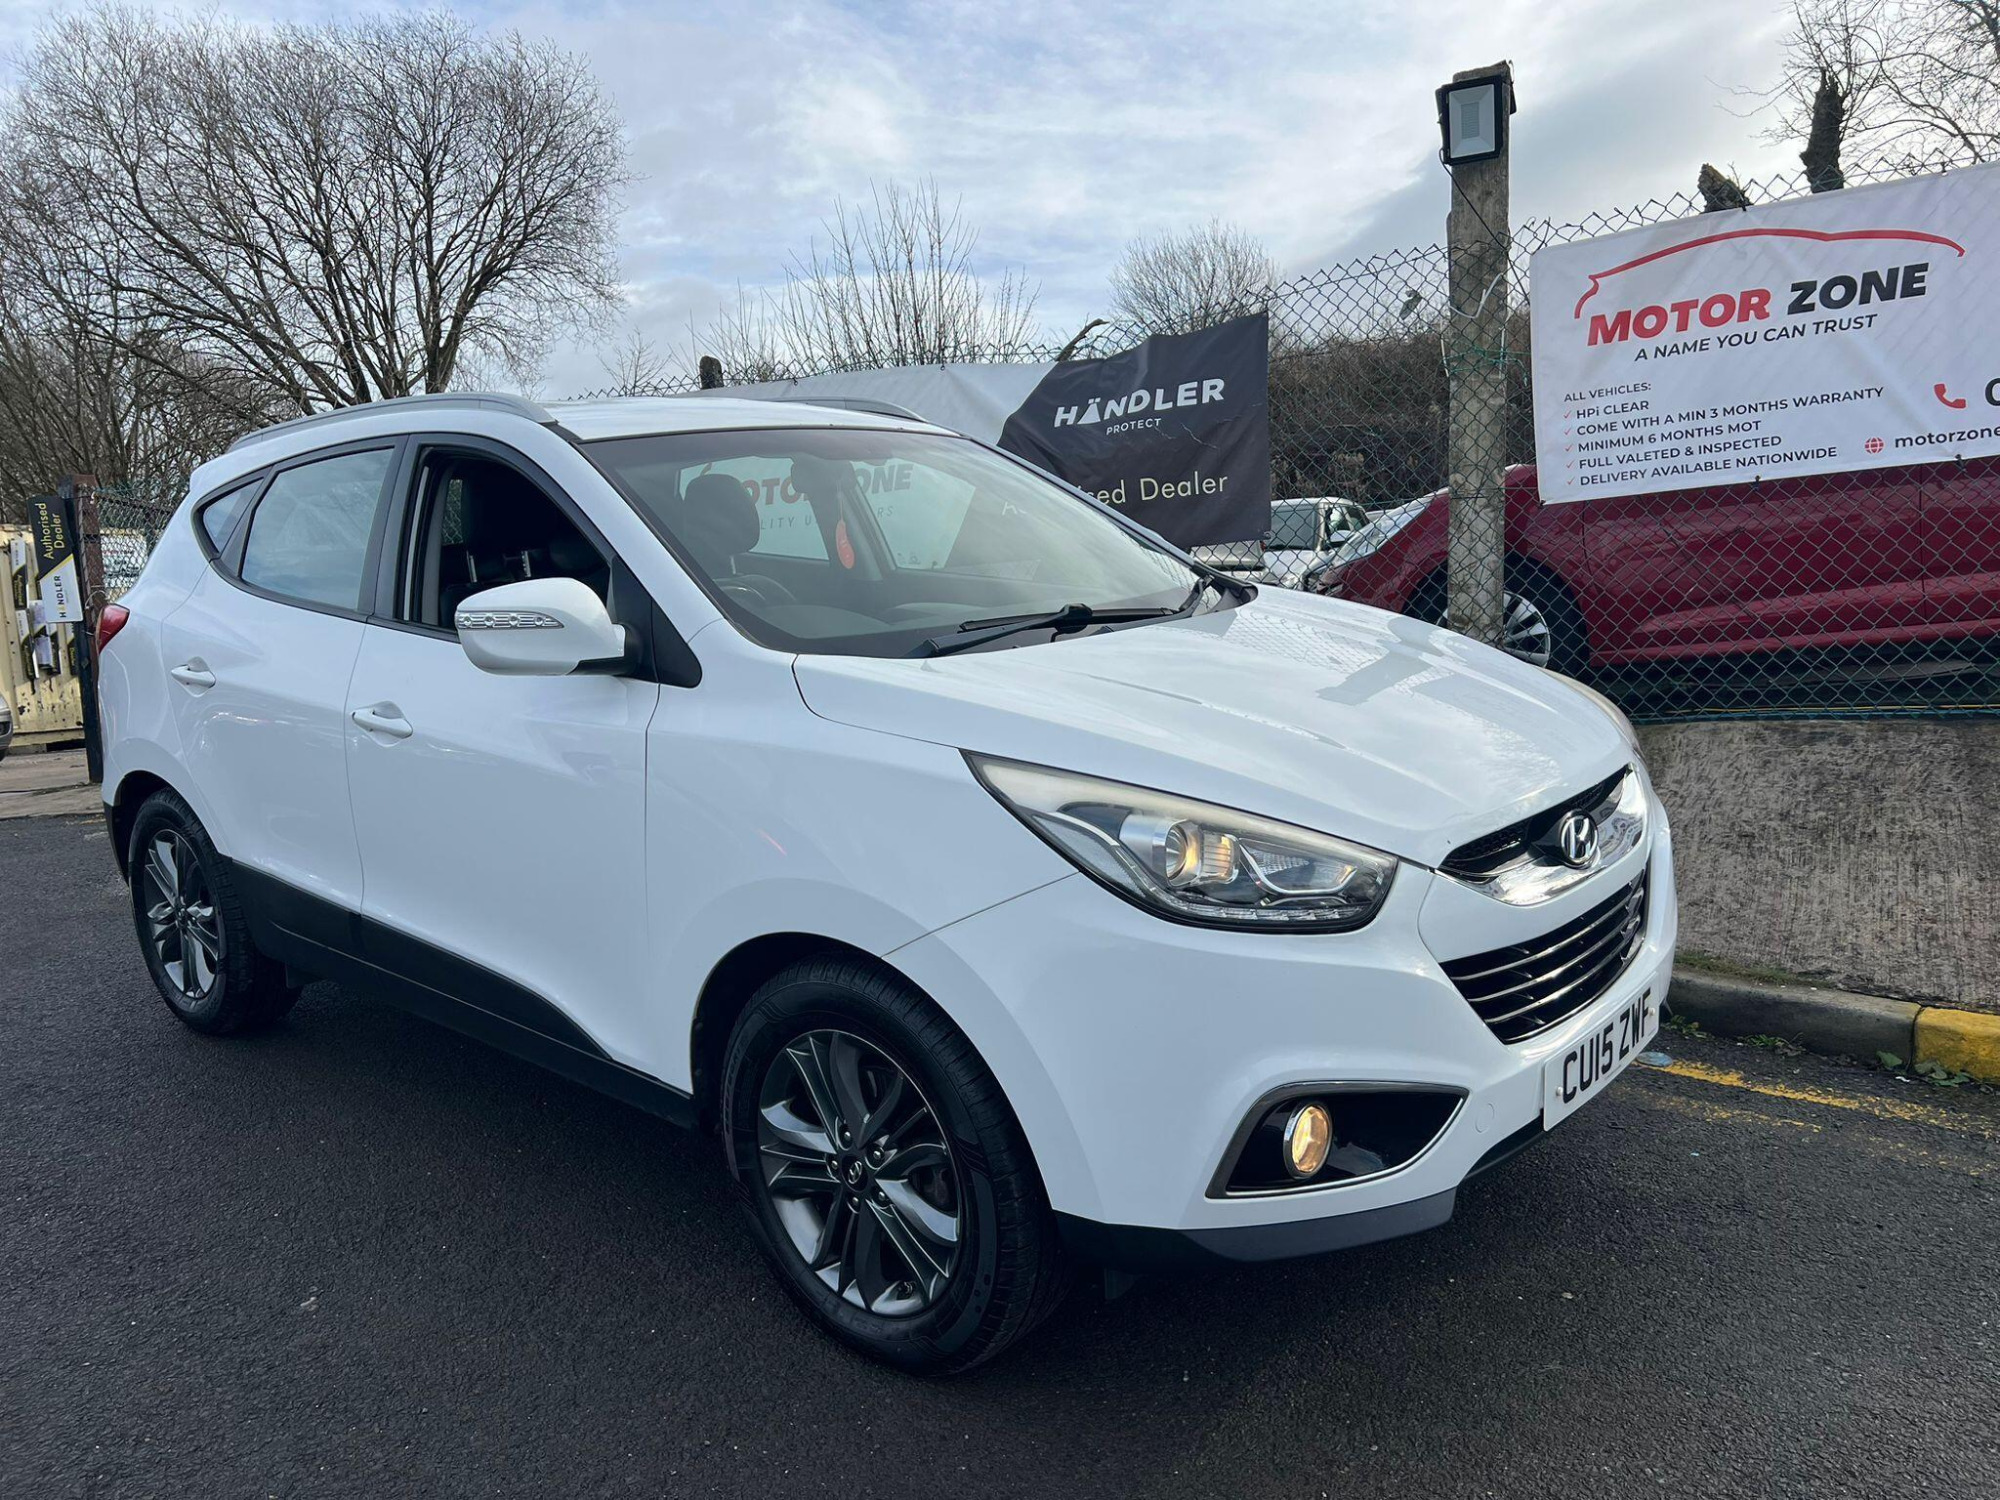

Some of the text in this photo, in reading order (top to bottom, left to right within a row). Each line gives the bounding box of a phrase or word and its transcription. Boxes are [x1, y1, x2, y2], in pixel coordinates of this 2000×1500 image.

[1586, 262, 1930, 346] MOTOR ZONE
[1634, 313, 1878, 362] A NAME YOU CAN TRUST
[1563, 382, 1652, 402] ALL VEHICLES:
[1576, 400, 1650, 419] HPi CLEAR
[1106, 418, 1162, 436] PROTECT
[1577, 386, 1884, 436] COME WITH A MIN 3 MONTHS WARRANTY
[1578, 420, 1762, 452] MINIMUM 6 MONTHS MOT
[1579, 435, 1782, 469] FULL VALETED & INSPECTED
[856, 463, 914, 494] ONE
[1580, 446, 1838, 486] DELIVERY AVAILABLE NATIONWIDE
[1140, 471, 1228, 502] Dealer
[34, 502, 54, 560] Authorised
[50, 513, 65, 549] Dealer
[1562, 987, 1651, 1104] CU15 ZWF
